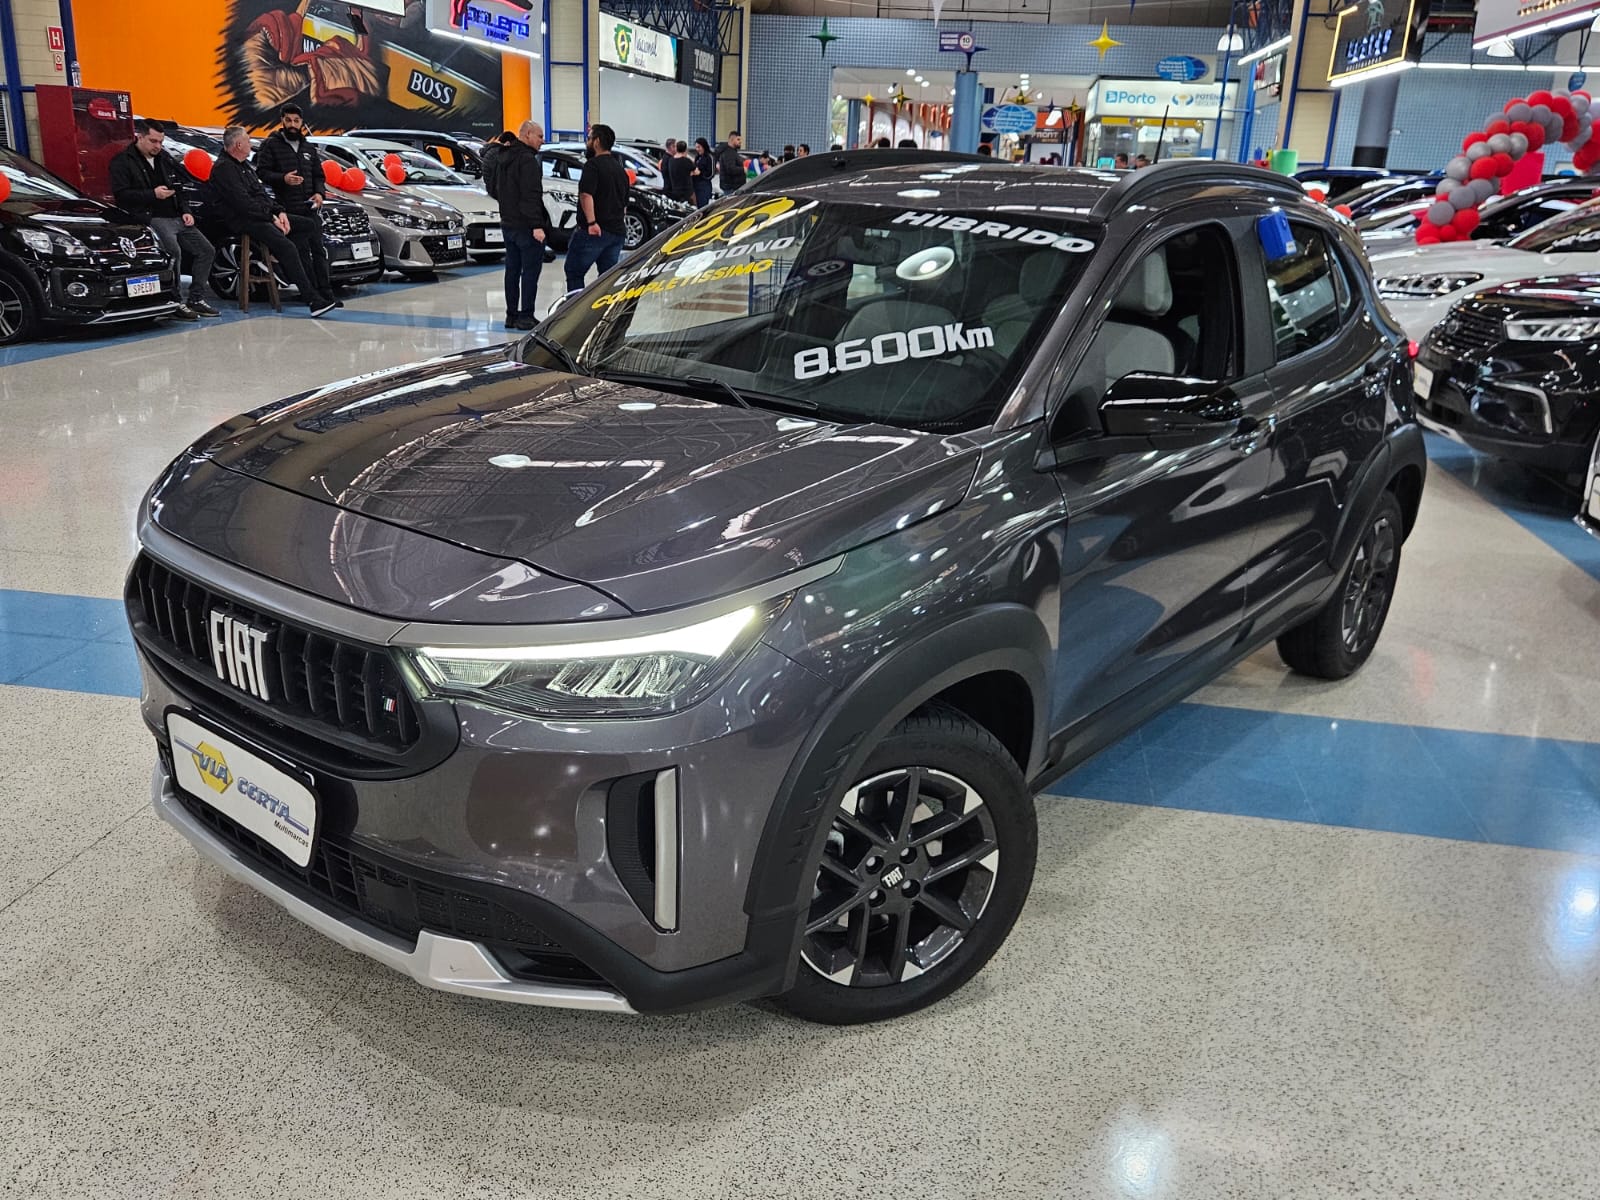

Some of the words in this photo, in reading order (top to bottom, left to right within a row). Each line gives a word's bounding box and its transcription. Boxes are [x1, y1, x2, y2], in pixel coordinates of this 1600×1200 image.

[51, 31, 61, 46] H
[410, 70, 453, 104] BOSS
[1118, 90, 1156, 105] Porto
[661, 196, 796, 256] 26
[793, 322, 996, 381] 8.600Km
[210, 609, 269, 702] FIAT
[200, 750, 230, 786] VIA
[237, 776, 292, 820] CERTA
[273, 818, 310, 849] Multimarcas
[881, 866, 904, 888] FIAT
